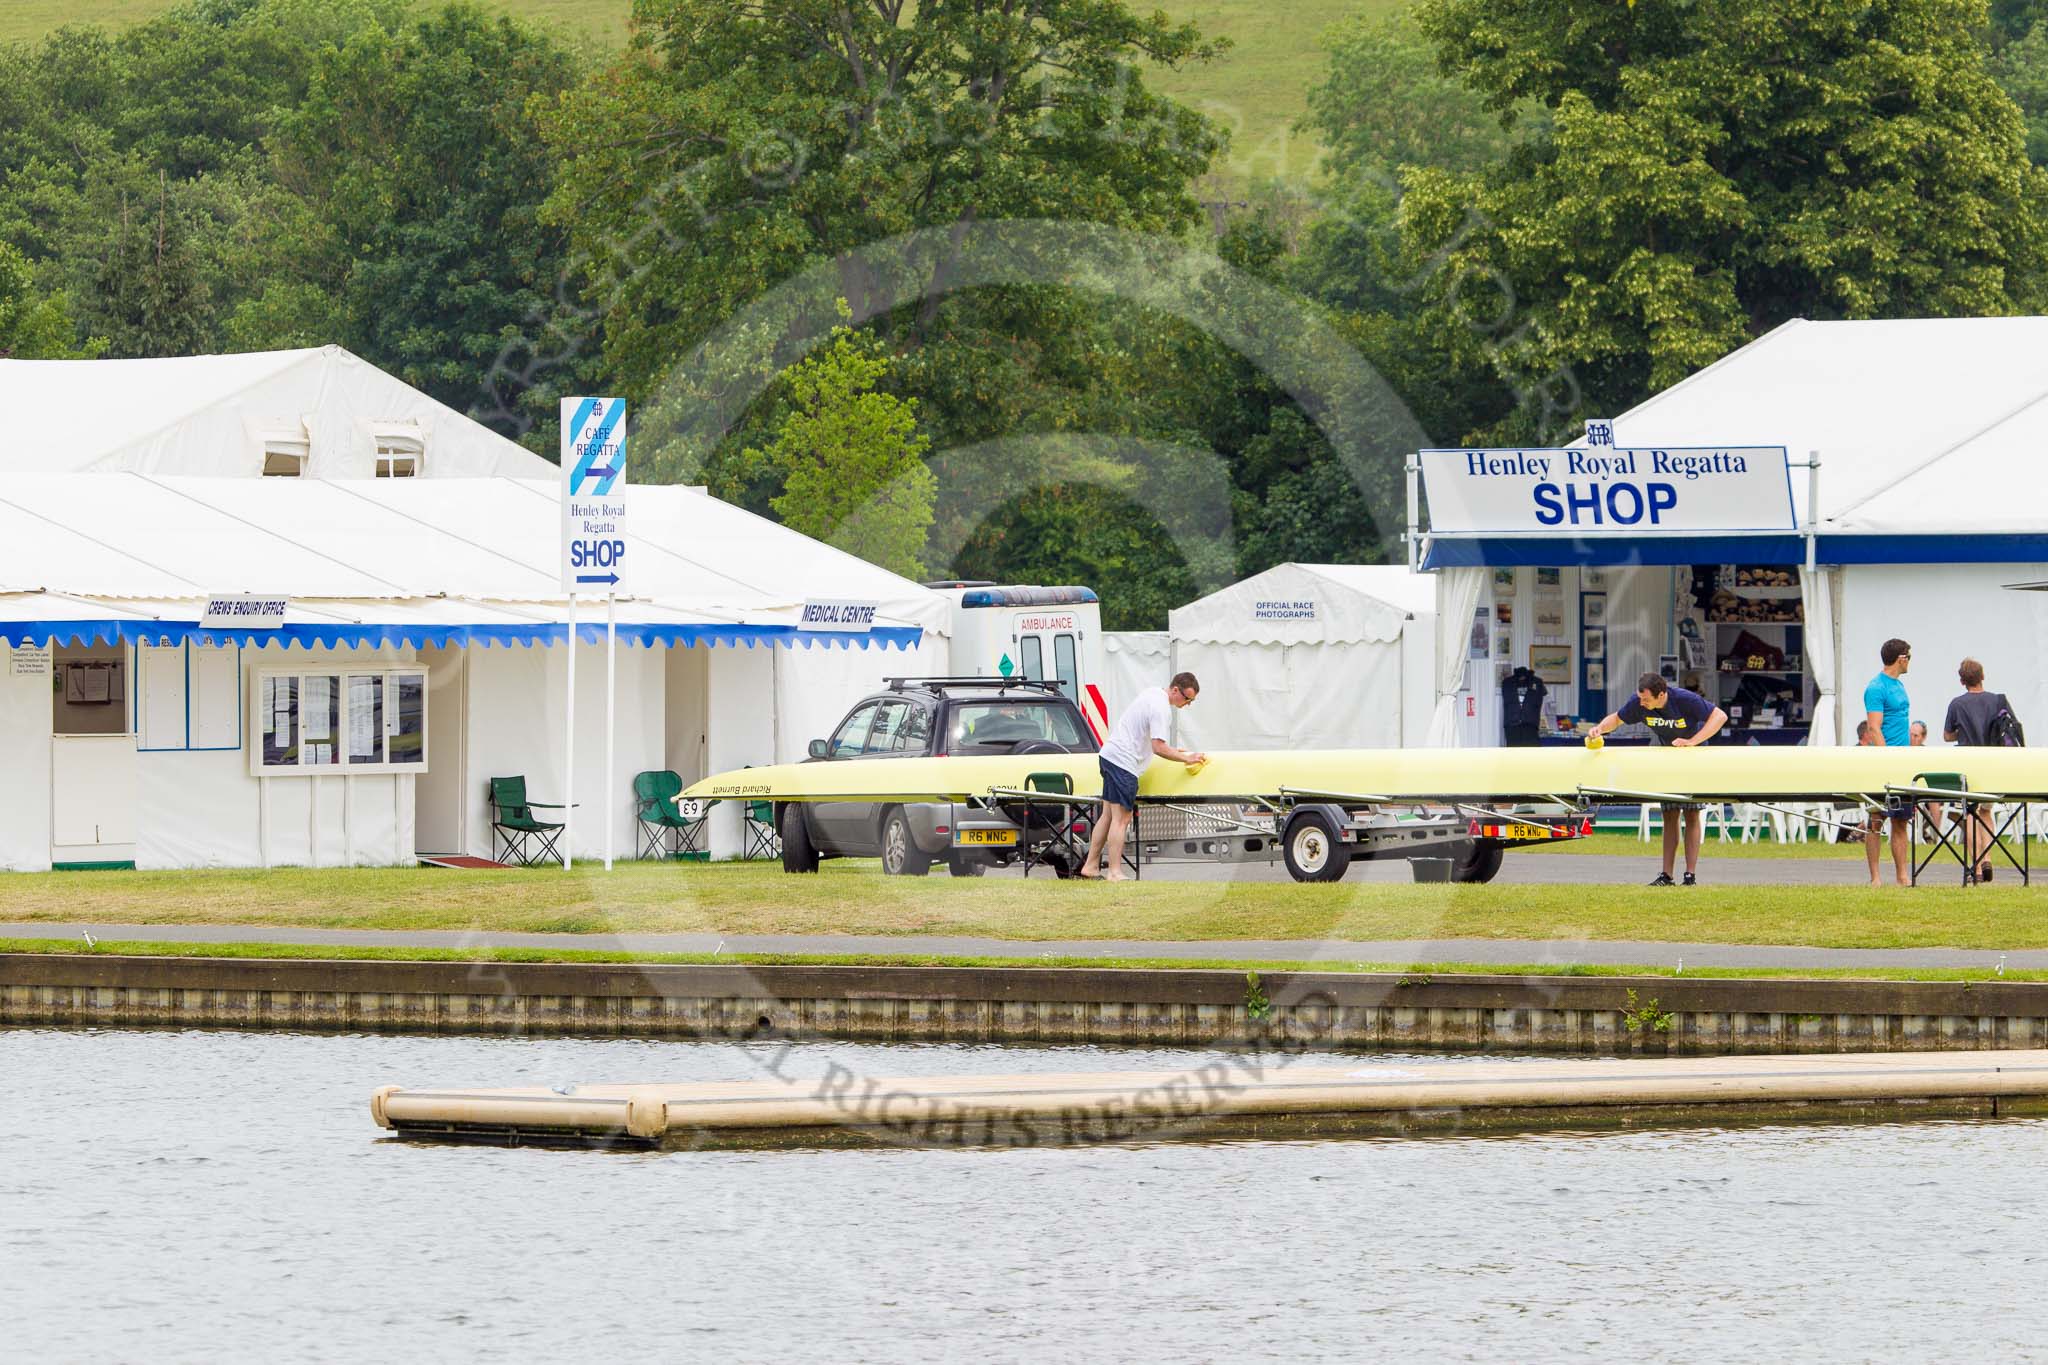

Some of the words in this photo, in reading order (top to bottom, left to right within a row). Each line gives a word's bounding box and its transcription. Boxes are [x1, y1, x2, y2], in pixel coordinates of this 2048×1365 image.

[586, 424, 610, 440] CAFÉ
[577, 443, 620, 456] REGATTA
[1466, 451, 1551, 481] Henley
[1567, 451, 1637, 481] Royal
[1653, 450, 1747, 480] Regatta
[1533, 482, 1677, 525] SHOP
[571, 503, 599, 520] Henley
[602, 503, 625, 520] Royal
[583, 520, 615, 535] Regatta
[571, 540, 625, 567] SHOP
[233, 601, 263, 616] ENQUIRY
[262, 601, 286, 616] OFFICE
[802, 604, 840, 623] MEDICAL
[841, 606, 876, 624] CENTRE
[1256, 610, 1315, 618] PHOTOGRAPHS
[1021, 617, 1073, 631] AMBULANCE
[713, 786, 740, 795] Burnett
[742, 785, 772, 794] Richard
[683, 803, 698, 815] 63
[968, 830, 983, 842] R6
[986, 830, 1007, 842] WNG
[1514, 825, 1525, 837] R6
